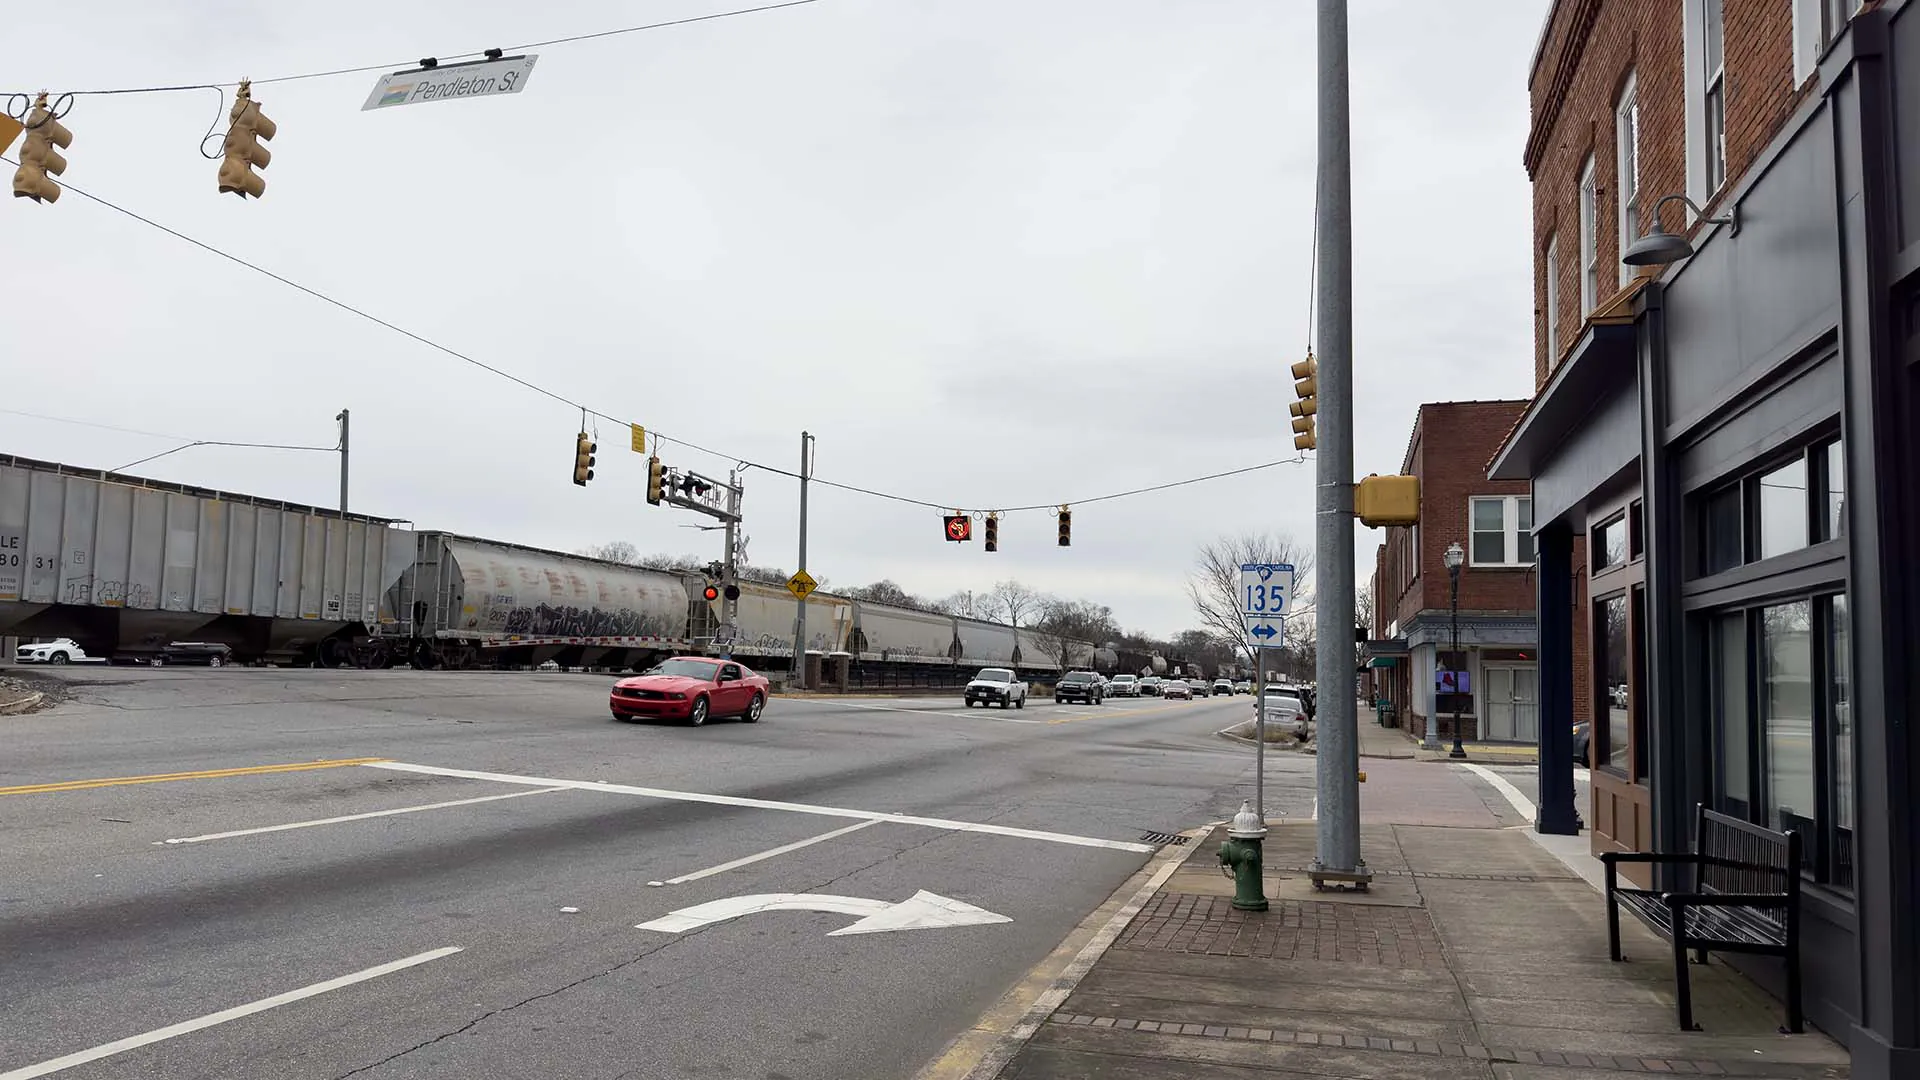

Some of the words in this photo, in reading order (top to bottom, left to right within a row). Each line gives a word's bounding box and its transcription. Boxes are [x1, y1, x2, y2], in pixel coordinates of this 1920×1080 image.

[410, 75, 496, 101] Pendleton
[498, 71, 520, 92] St
[1247, 584, 1284, 612] 135
